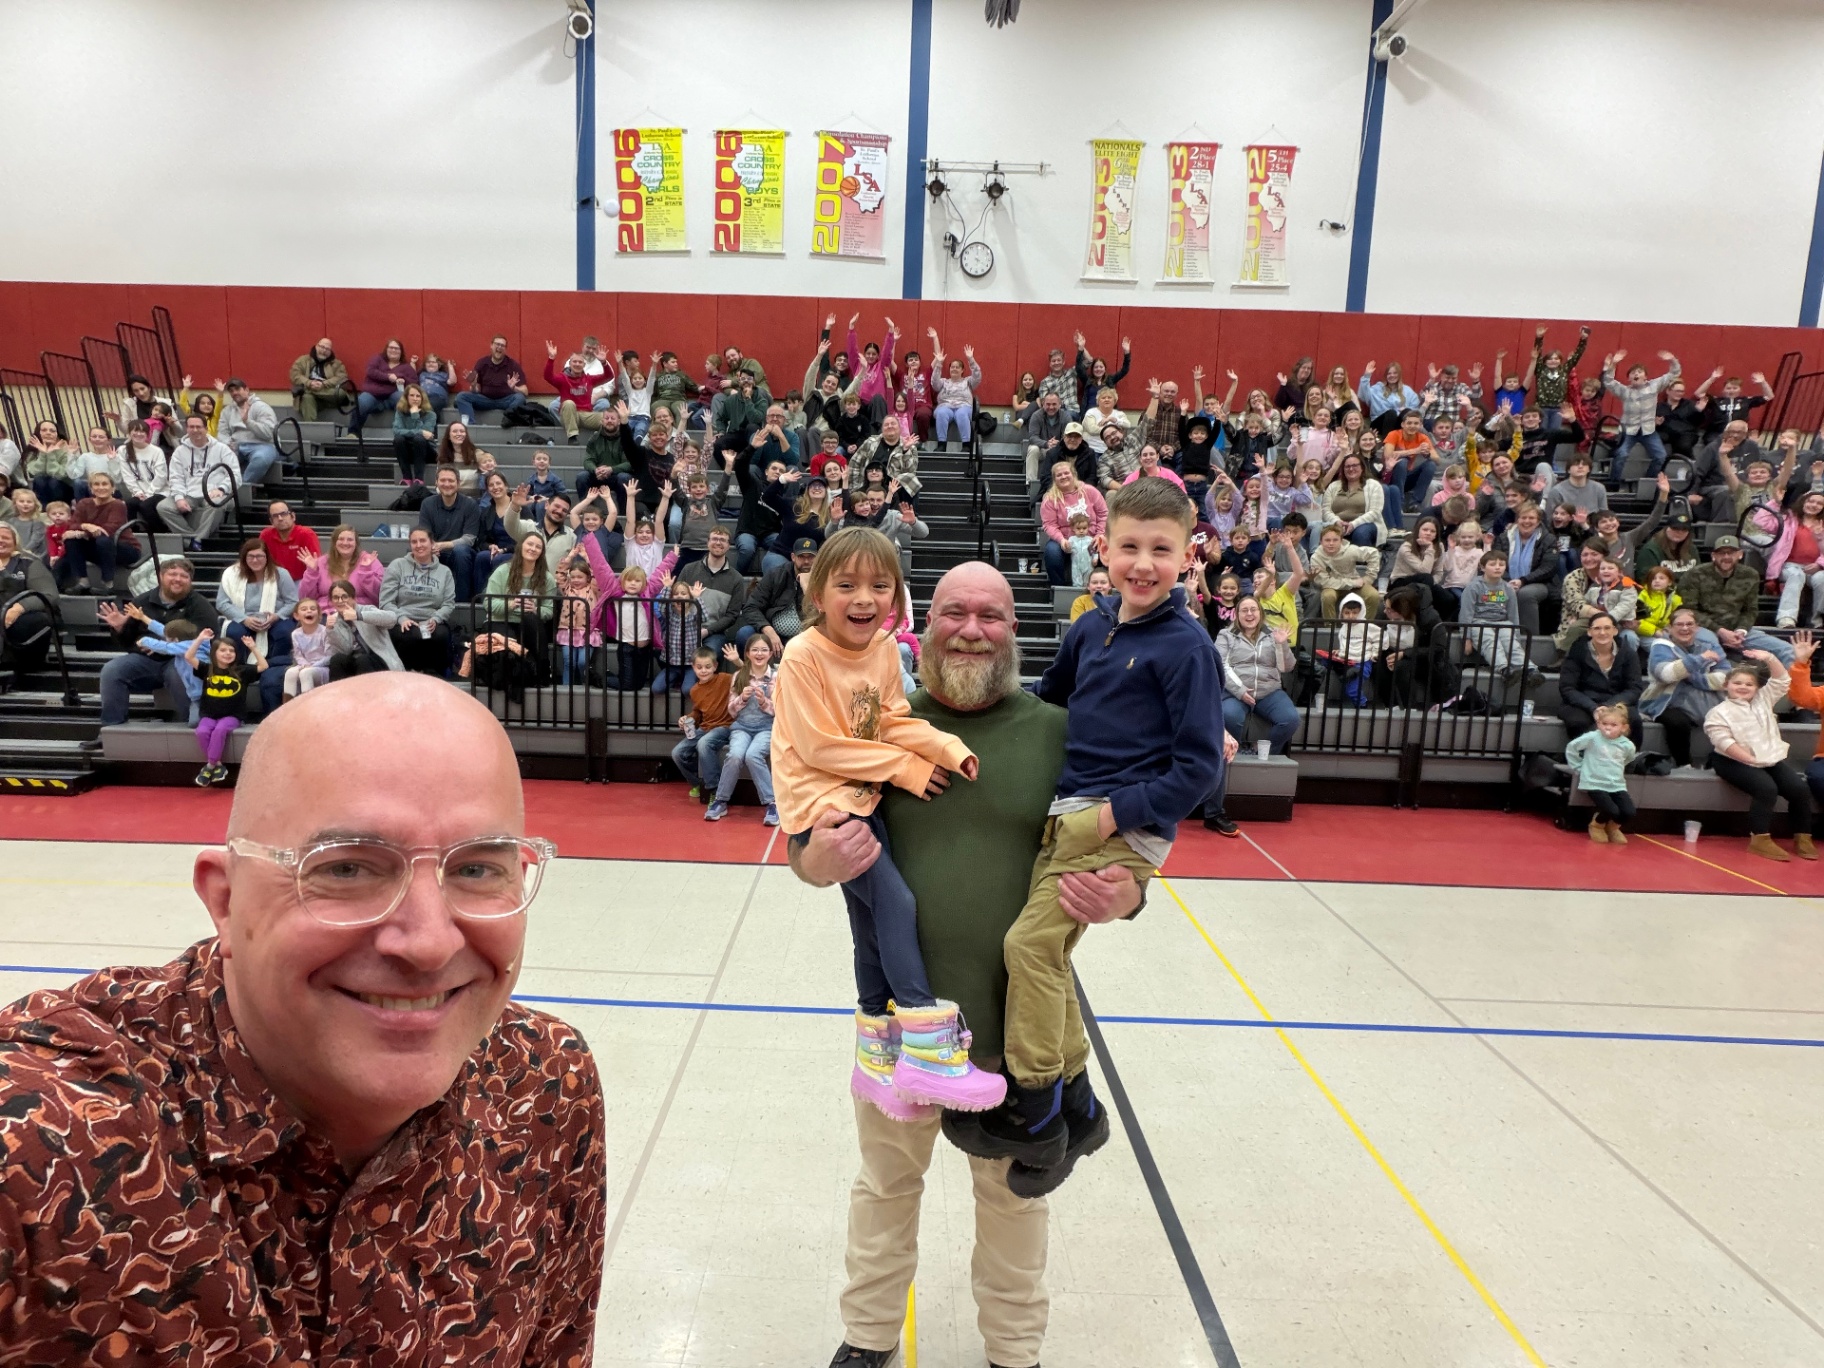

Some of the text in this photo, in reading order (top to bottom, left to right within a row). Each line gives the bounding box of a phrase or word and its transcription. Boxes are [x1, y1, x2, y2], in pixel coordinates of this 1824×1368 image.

[1094, 142, 1140, 152] NATIONALS
[854, 163, 881, 192] LSA
[613, 129, 644, 252] 2006
[648, 185, 680, 193] GIRLS
[714, 130, 742, 252] 2006
[746, 187, 779, 195] BOYS
[812, 130, 846, 254] 2007
[645, 196, 663, 206] 2nd
[744, 197, 761, 207] 3rd
[404, 575, 418, 585] KEY
